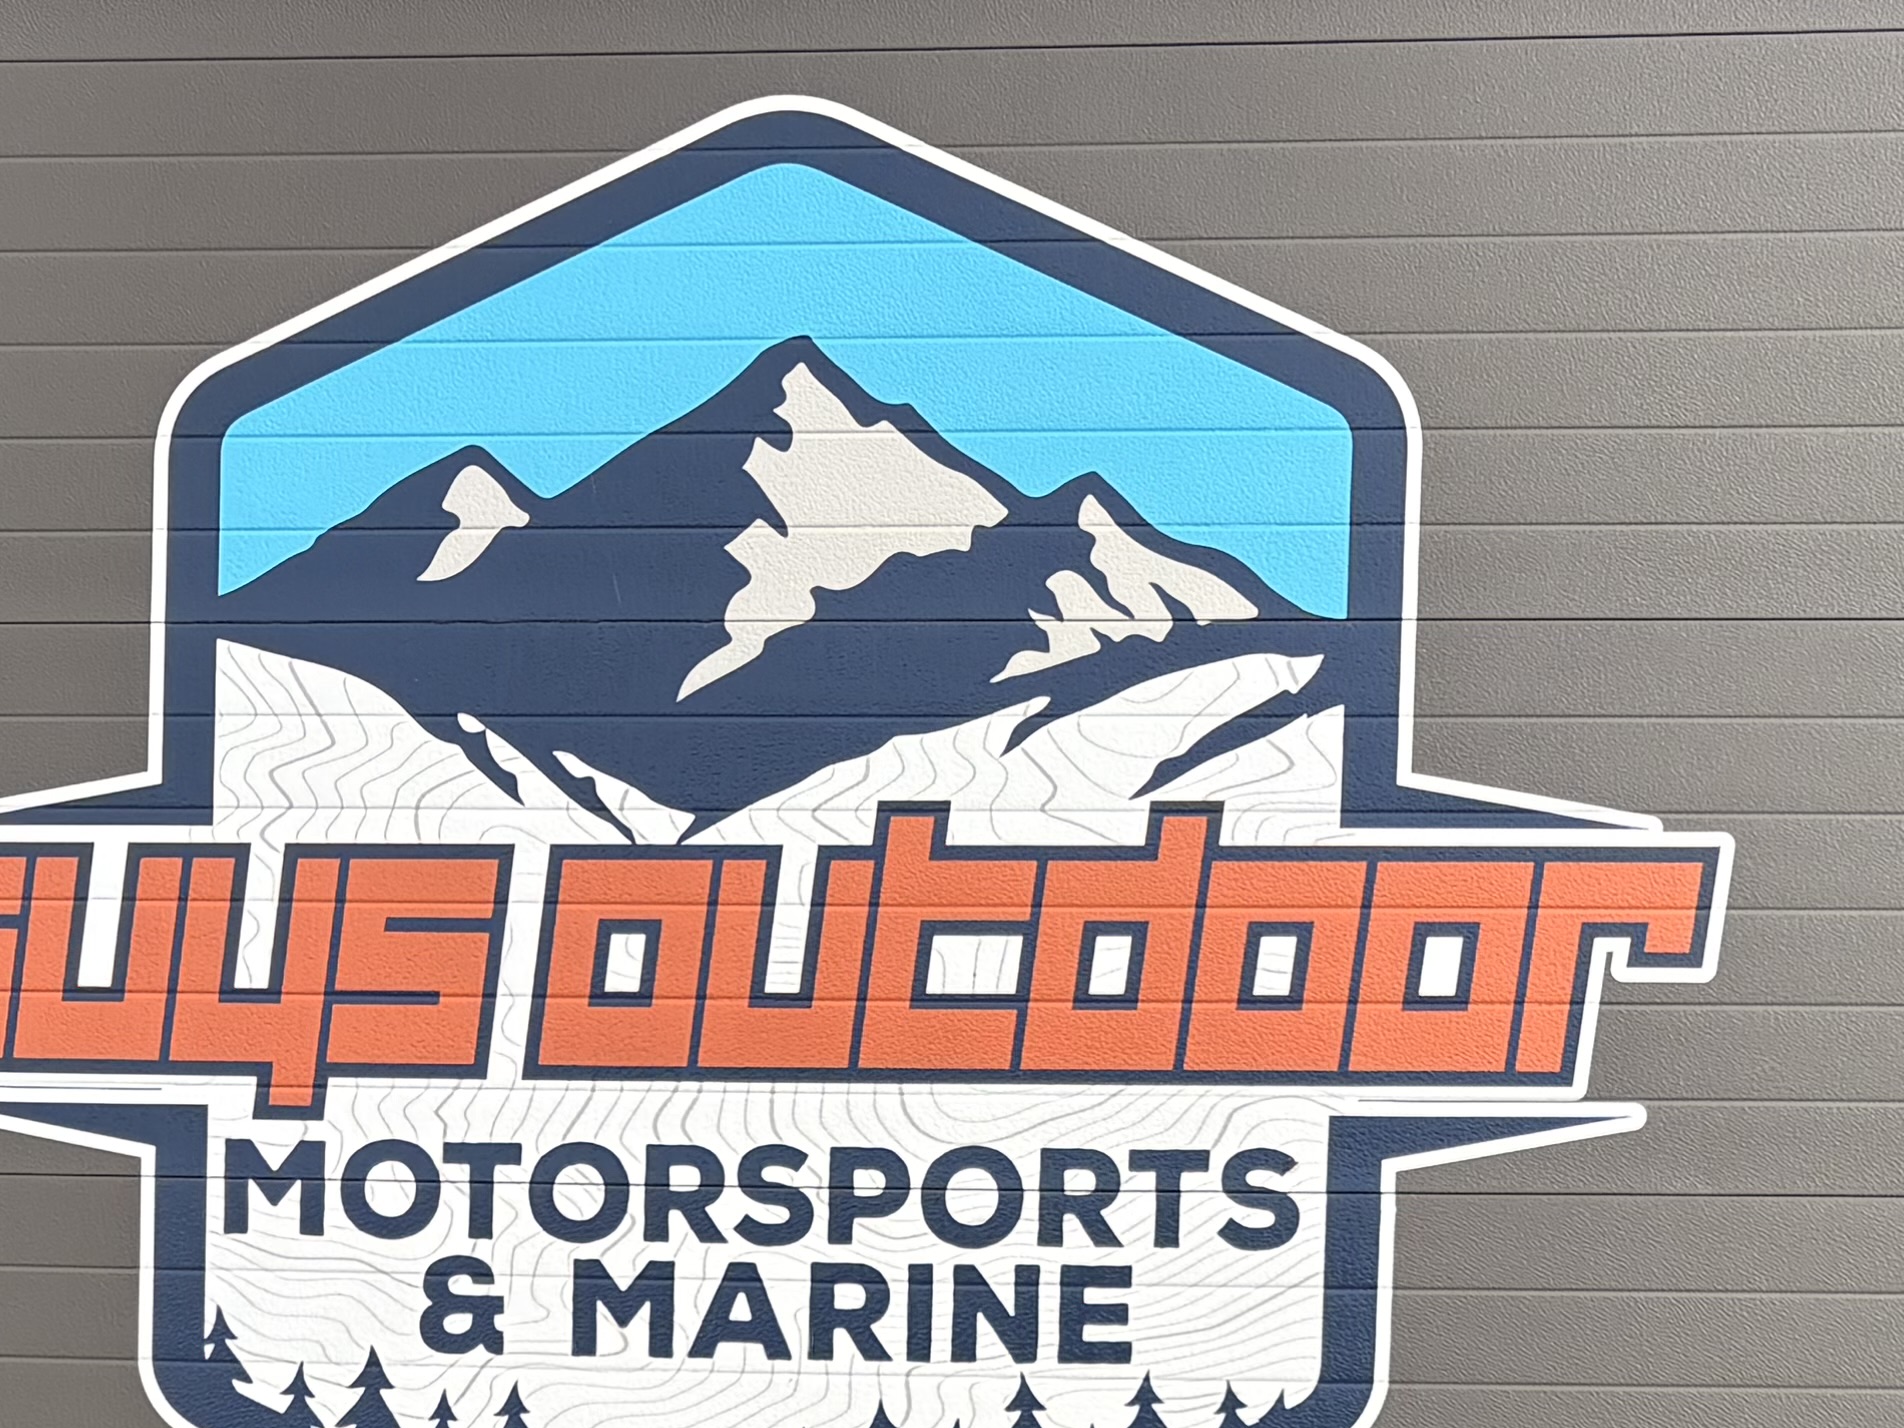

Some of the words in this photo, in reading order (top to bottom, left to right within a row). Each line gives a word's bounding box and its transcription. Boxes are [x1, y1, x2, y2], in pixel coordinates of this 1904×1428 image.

[222, 1137, 1301, 1252] MOTORSPORTS
[418, 1256, 505, 1356] &
[572, 1260, 1134, 1365] MARINE
